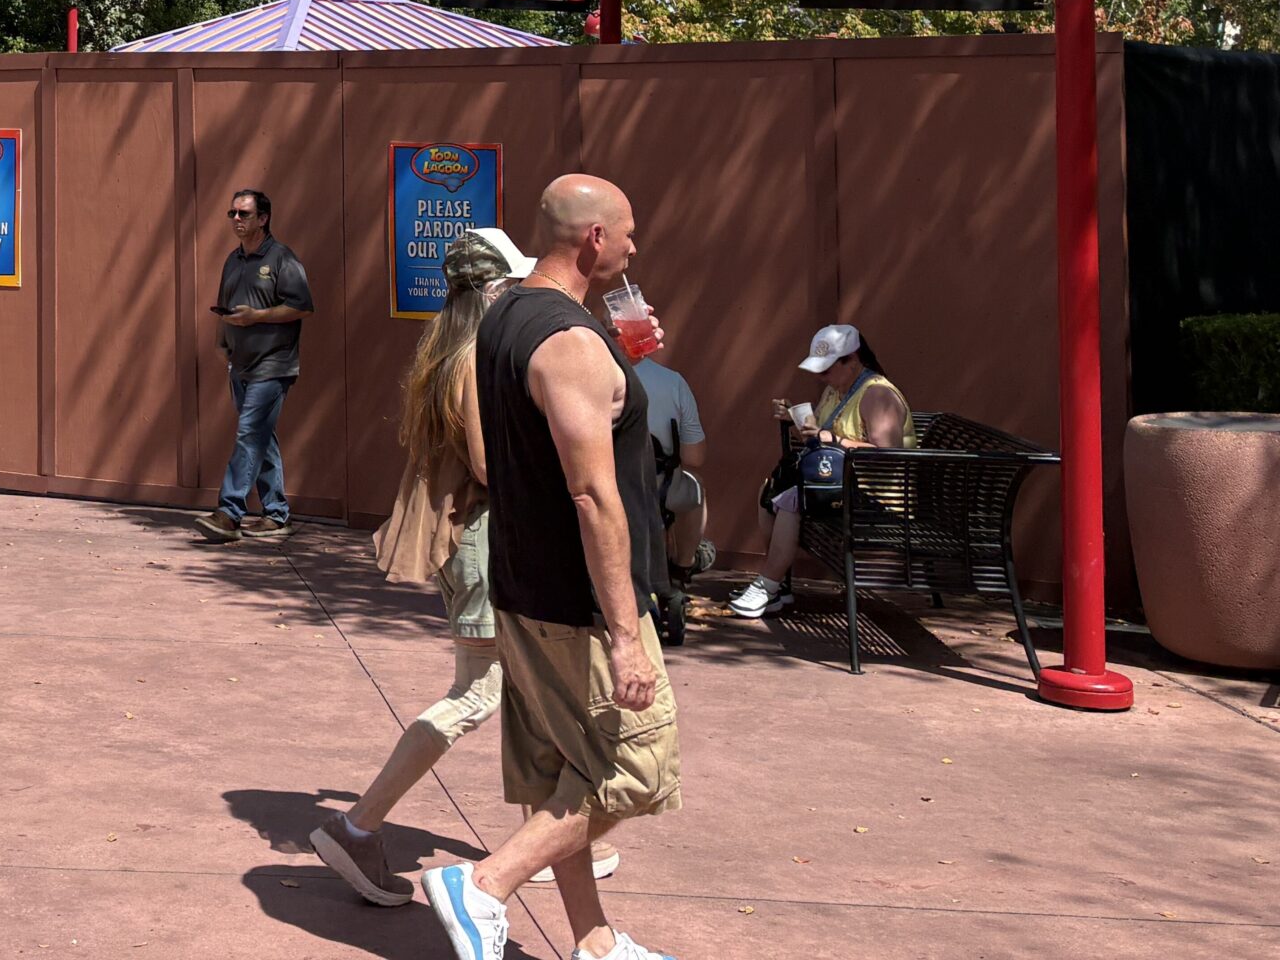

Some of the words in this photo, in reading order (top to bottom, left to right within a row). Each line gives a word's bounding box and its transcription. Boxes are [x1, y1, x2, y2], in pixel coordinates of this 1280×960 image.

[417, 200, 472, 218] PLEASE
[407, 241, 438, 258] OUR
[414, 277, 440, 287] THANK
[407, 287, 429, 297] YOUR
